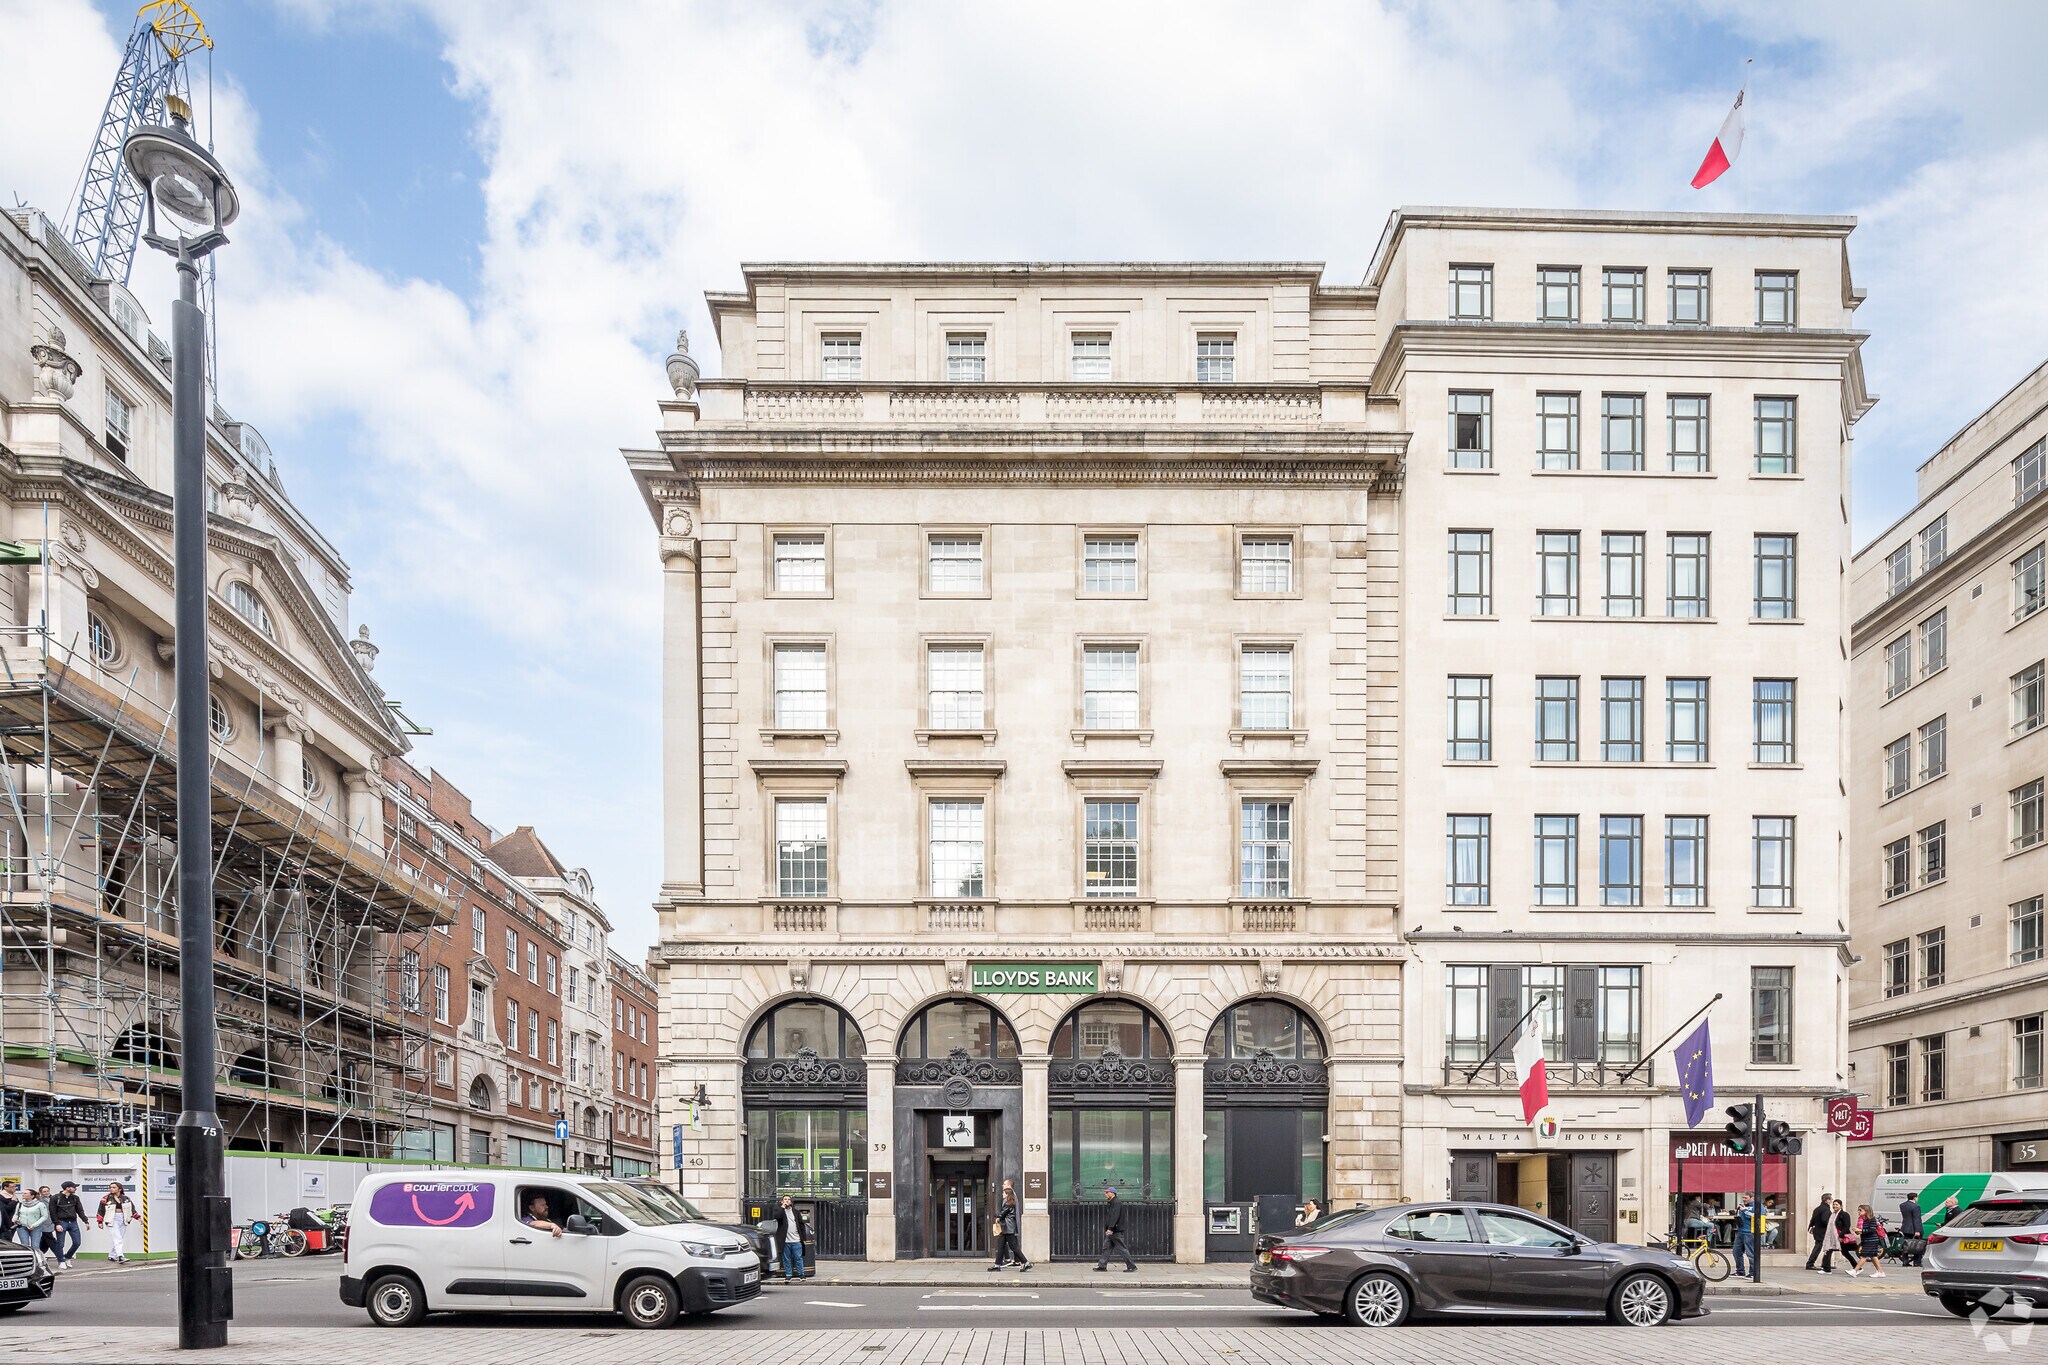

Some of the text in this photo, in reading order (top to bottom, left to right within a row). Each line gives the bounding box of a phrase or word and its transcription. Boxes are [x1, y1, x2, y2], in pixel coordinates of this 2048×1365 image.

[973, 971, 1095, 986] LLOYDS BANK
[1835, 1110, 1848, 1120] PRET
[1855, 1121, 1866, 1131] RET
[202, 1126, 217, 1136] 75
[1462, 1133, 1622, 1141] MALTA HOUSE
[874, 1143, 887, 1152] 39
[1028, 1144, 1041, 1152] 39
[1686, 1142, 1708, 1156] PRET
[1710, 1143, 1717, 1156] A
[2019, 1144, 2037, 1160] 35
[689, 1158, 703, 1166] 40
[1963, 1241, 1998, 1250] KE21 UJM
[10, 1279, 25, 1288] BXP
